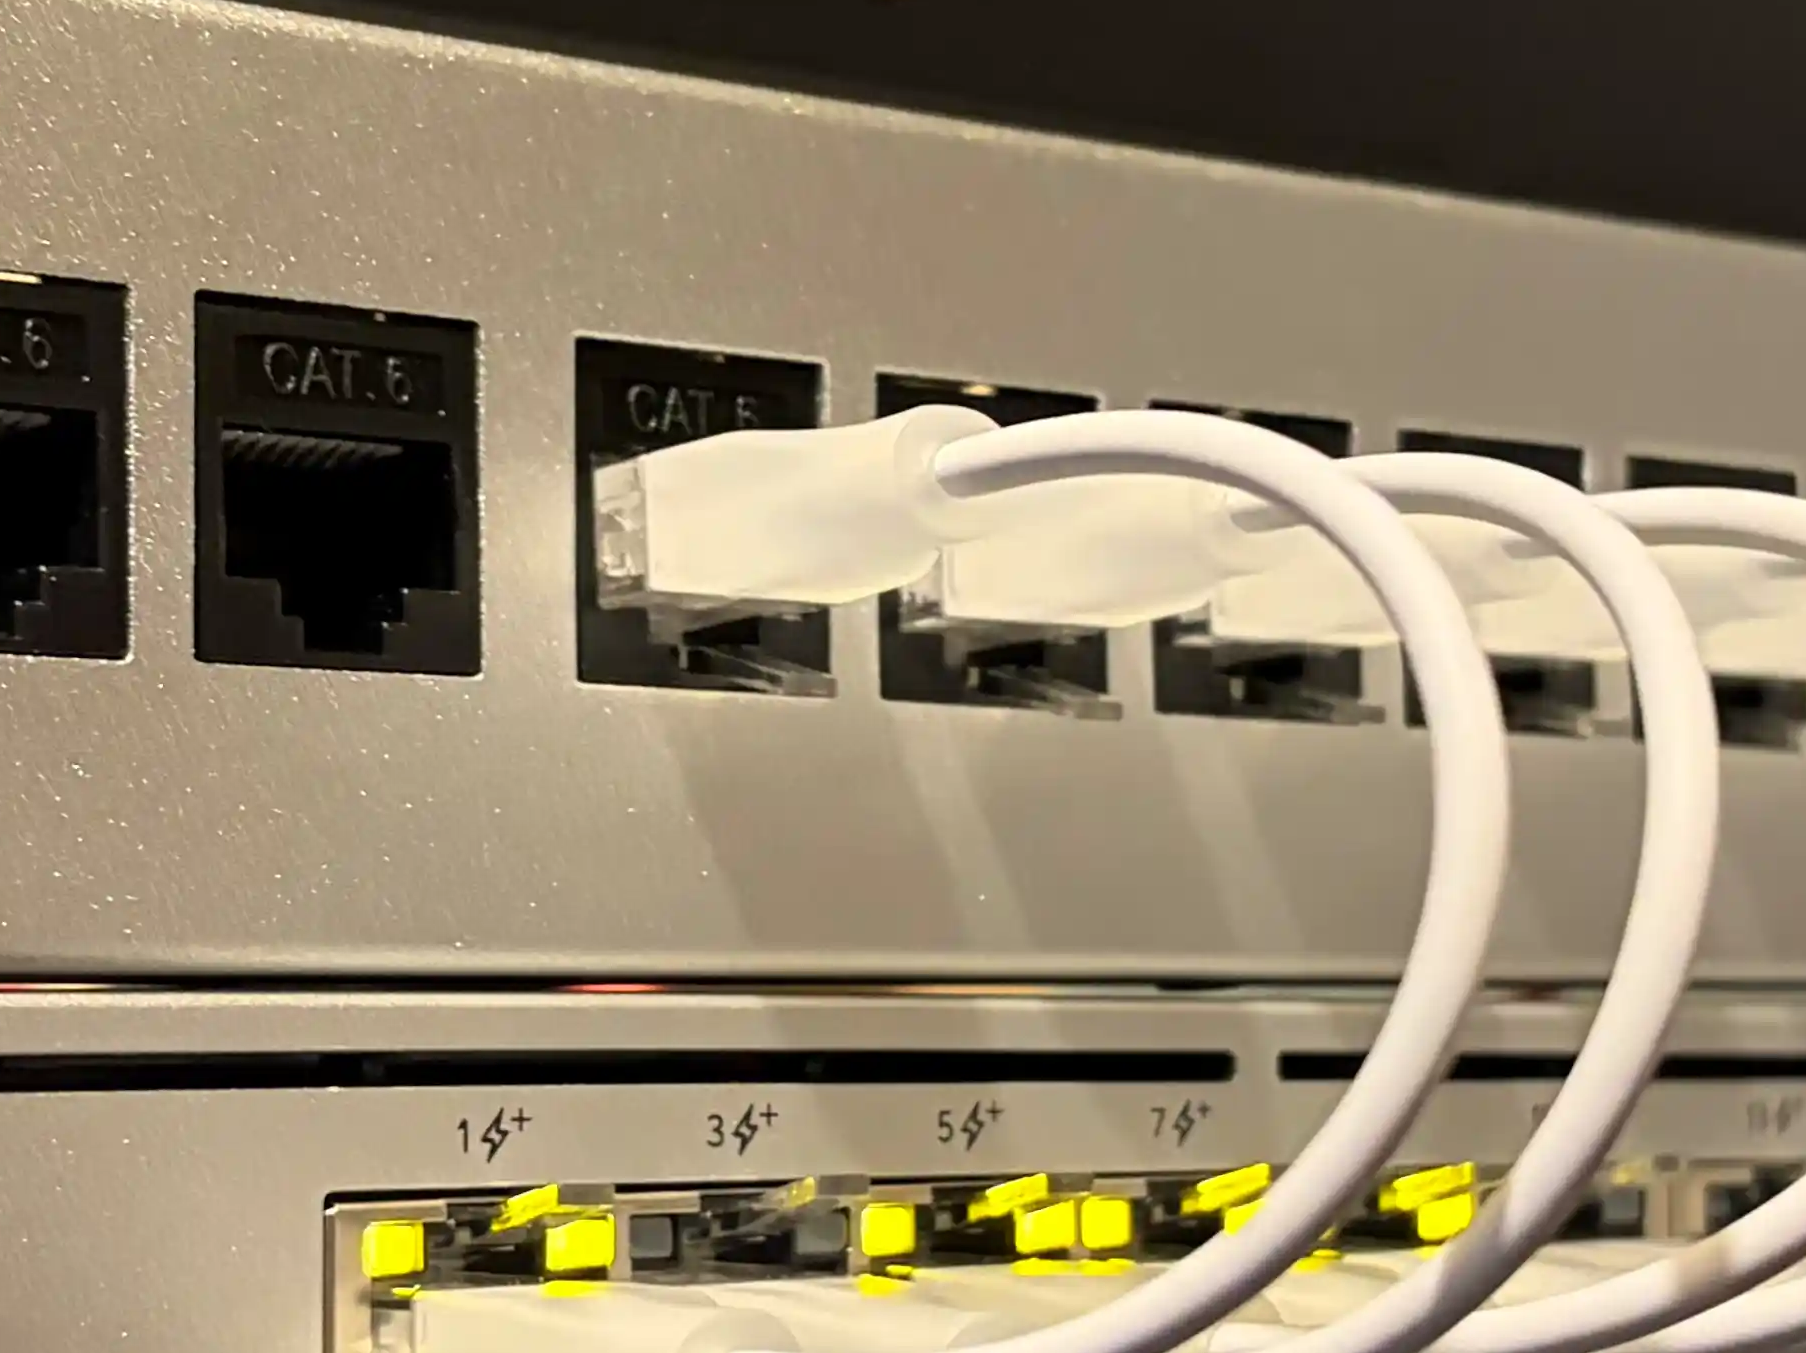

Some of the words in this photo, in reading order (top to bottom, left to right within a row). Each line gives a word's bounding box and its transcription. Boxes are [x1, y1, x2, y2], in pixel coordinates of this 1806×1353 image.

[22, 317, 54, 370] 6
[261, 341, 377, 400] CAT.
[385, 355, 414, 404] 6
[457, 1117, 469, 1153] 1
[706, 1113, 725, 1149] 3
[937, 1110, 955, 1143] 5
[1149, 1106, 1167, 1139] 7
